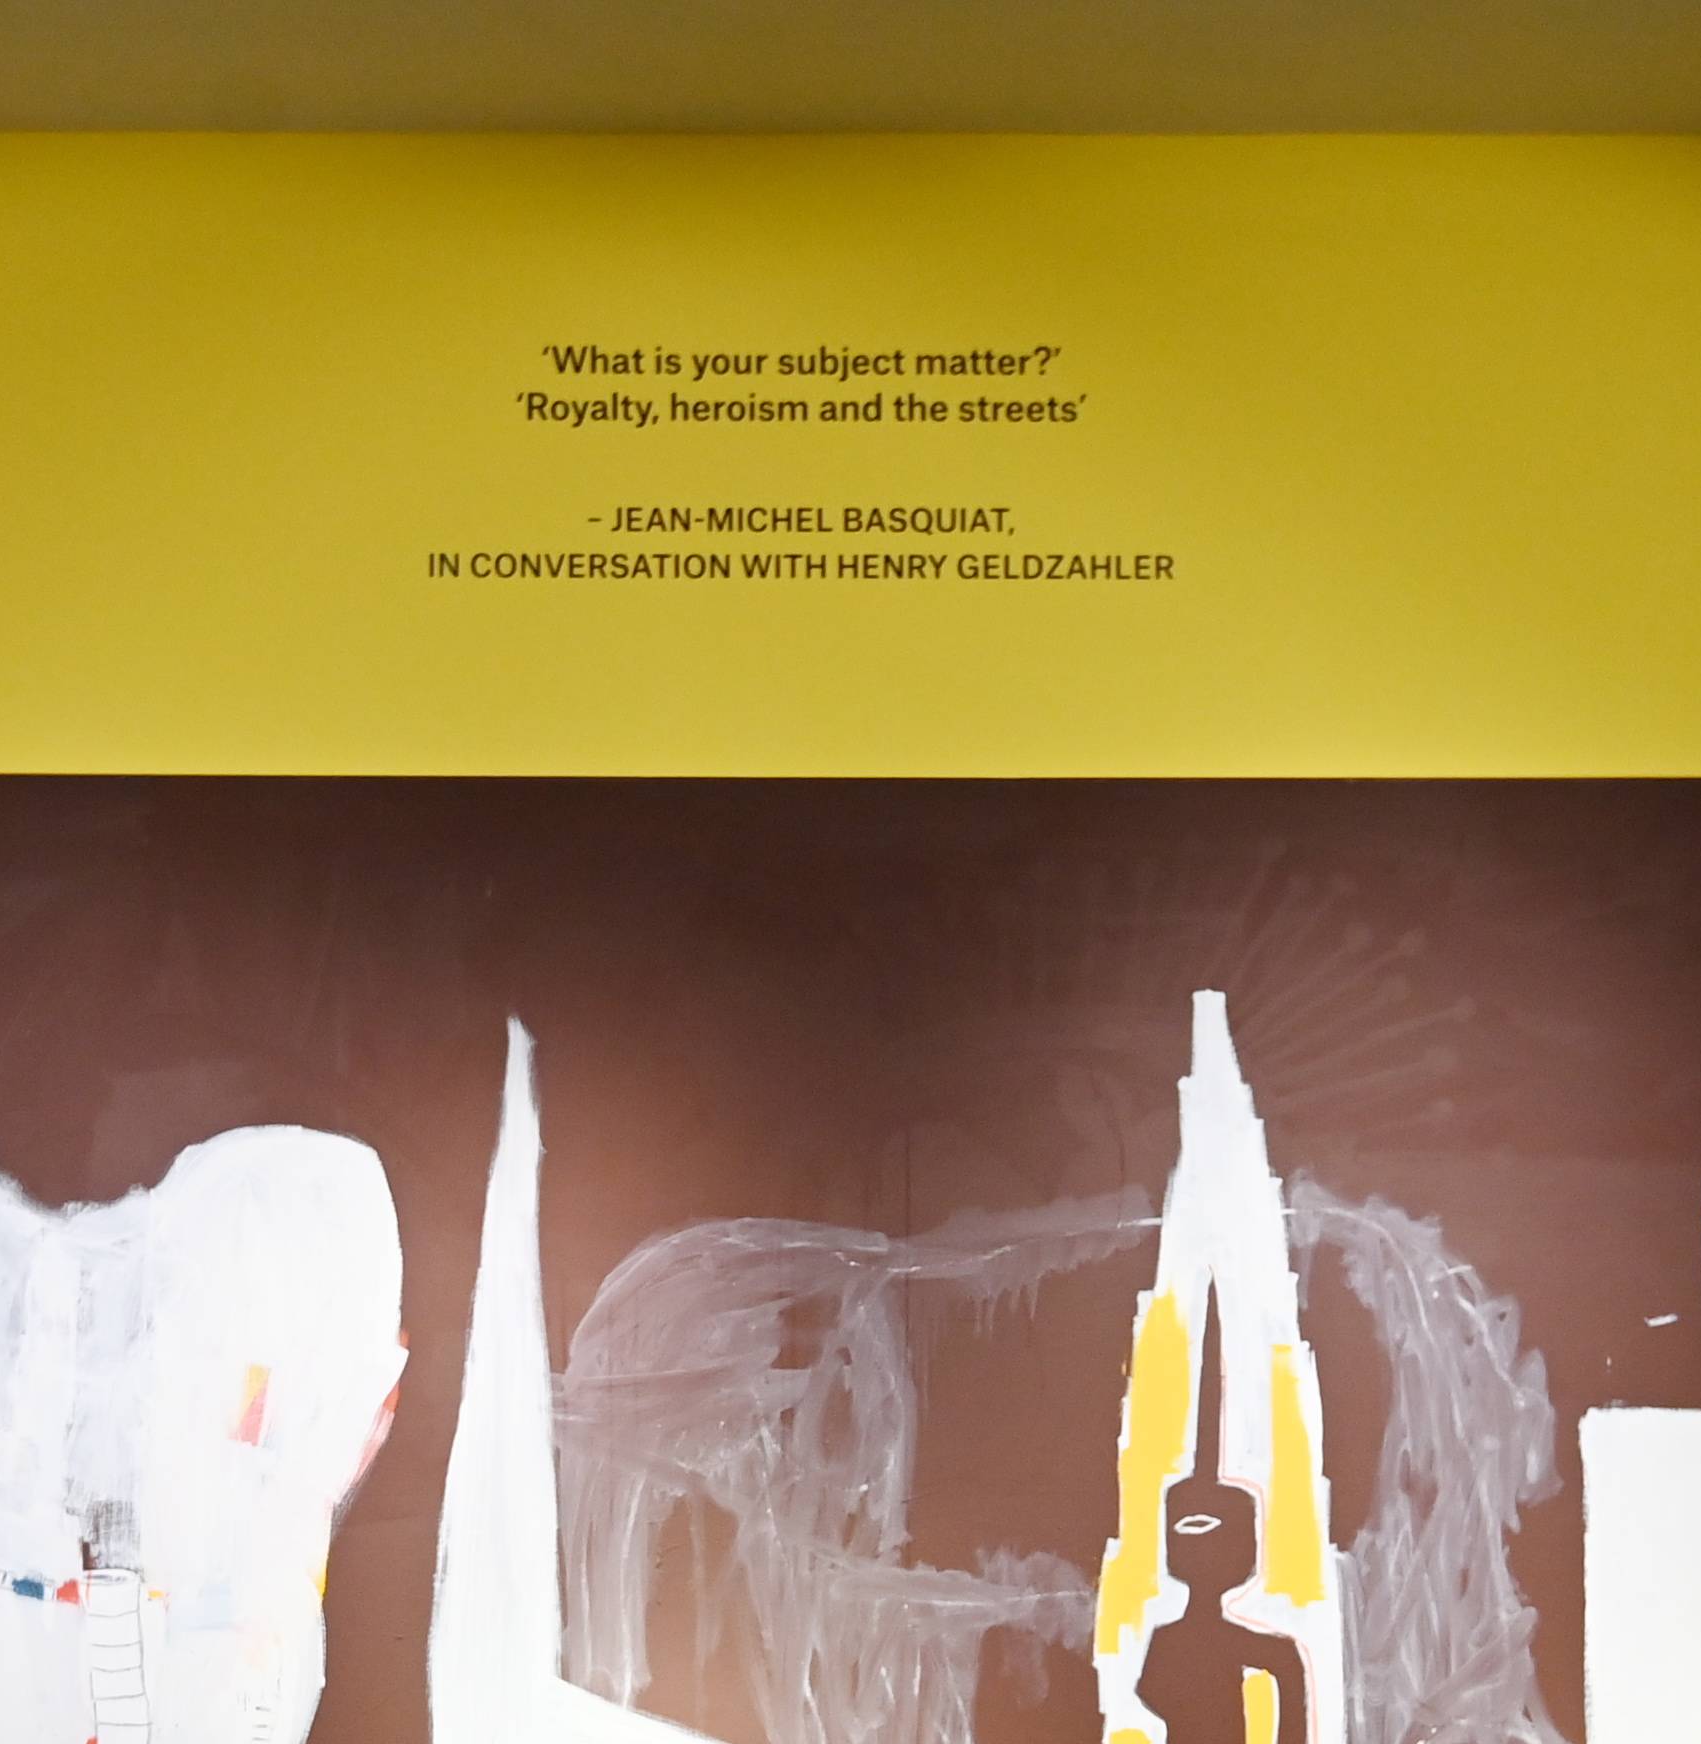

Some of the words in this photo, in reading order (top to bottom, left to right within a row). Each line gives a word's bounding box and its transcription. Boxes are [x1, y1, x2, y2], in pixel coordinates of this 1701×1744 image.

[656, 346, 681, 375] is
[692, 353, 768, 382] your
[778, 345, 905, 383] subject
[671, 392, 809, 423] heroism
[820, 393, 883, 423] and
[892, 393, 949, 423] the
[611, 507, 834, 533] JEAN-MICHEL
[843, 507, 1016, 536] BASQUIAT,
[428, 552, 460, 579] IN
[470, 552, 731, 580] CONVERSATION
[740, 553, 827, 580] WITH
[837, 553, 948, 580] HENRY
[956, 553, 1175, 580] GELDZAHLER
